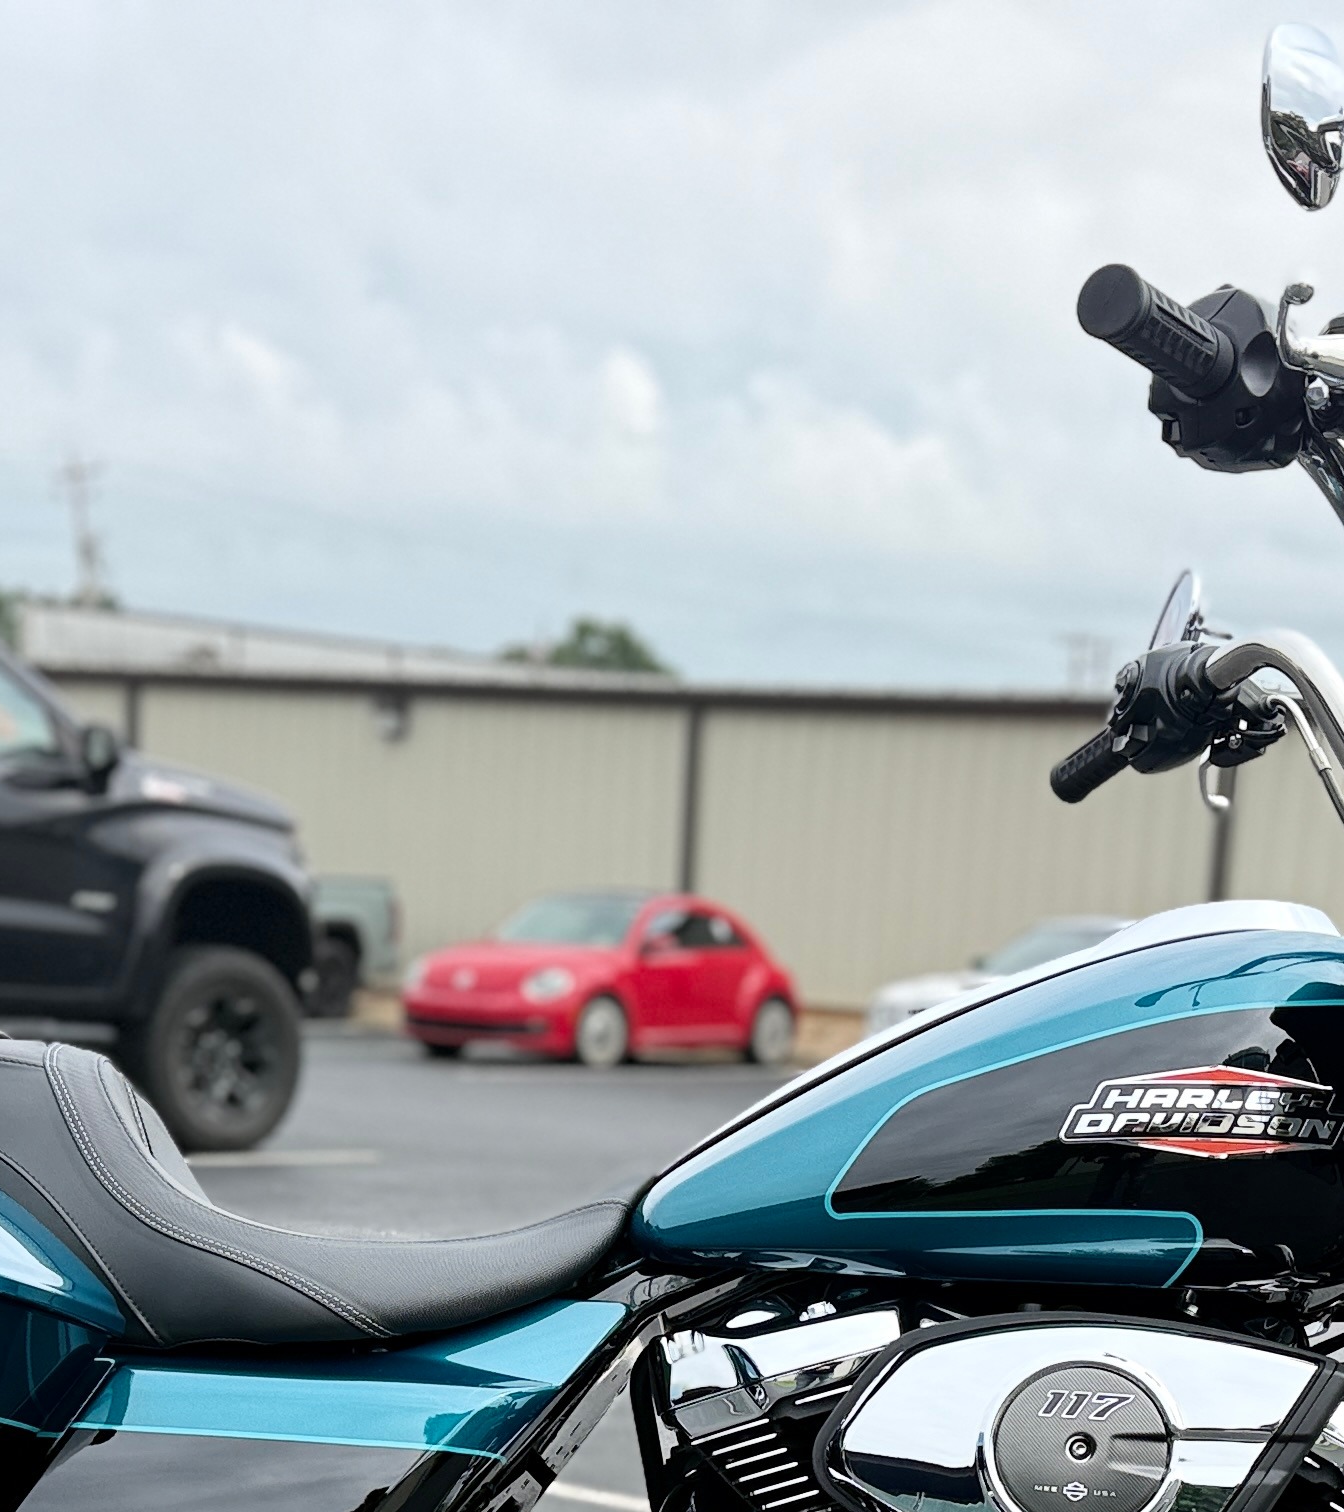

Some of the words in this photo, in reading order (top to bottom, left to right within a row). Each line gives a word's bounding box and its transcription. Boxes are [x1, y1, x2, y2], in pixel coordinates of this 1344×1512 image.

[1074, 1112, 1336, 1139] DAVIDSON
[1037, 1390, 1136, 1421] 117
[1093, 1489, 1117, 1498] USA
